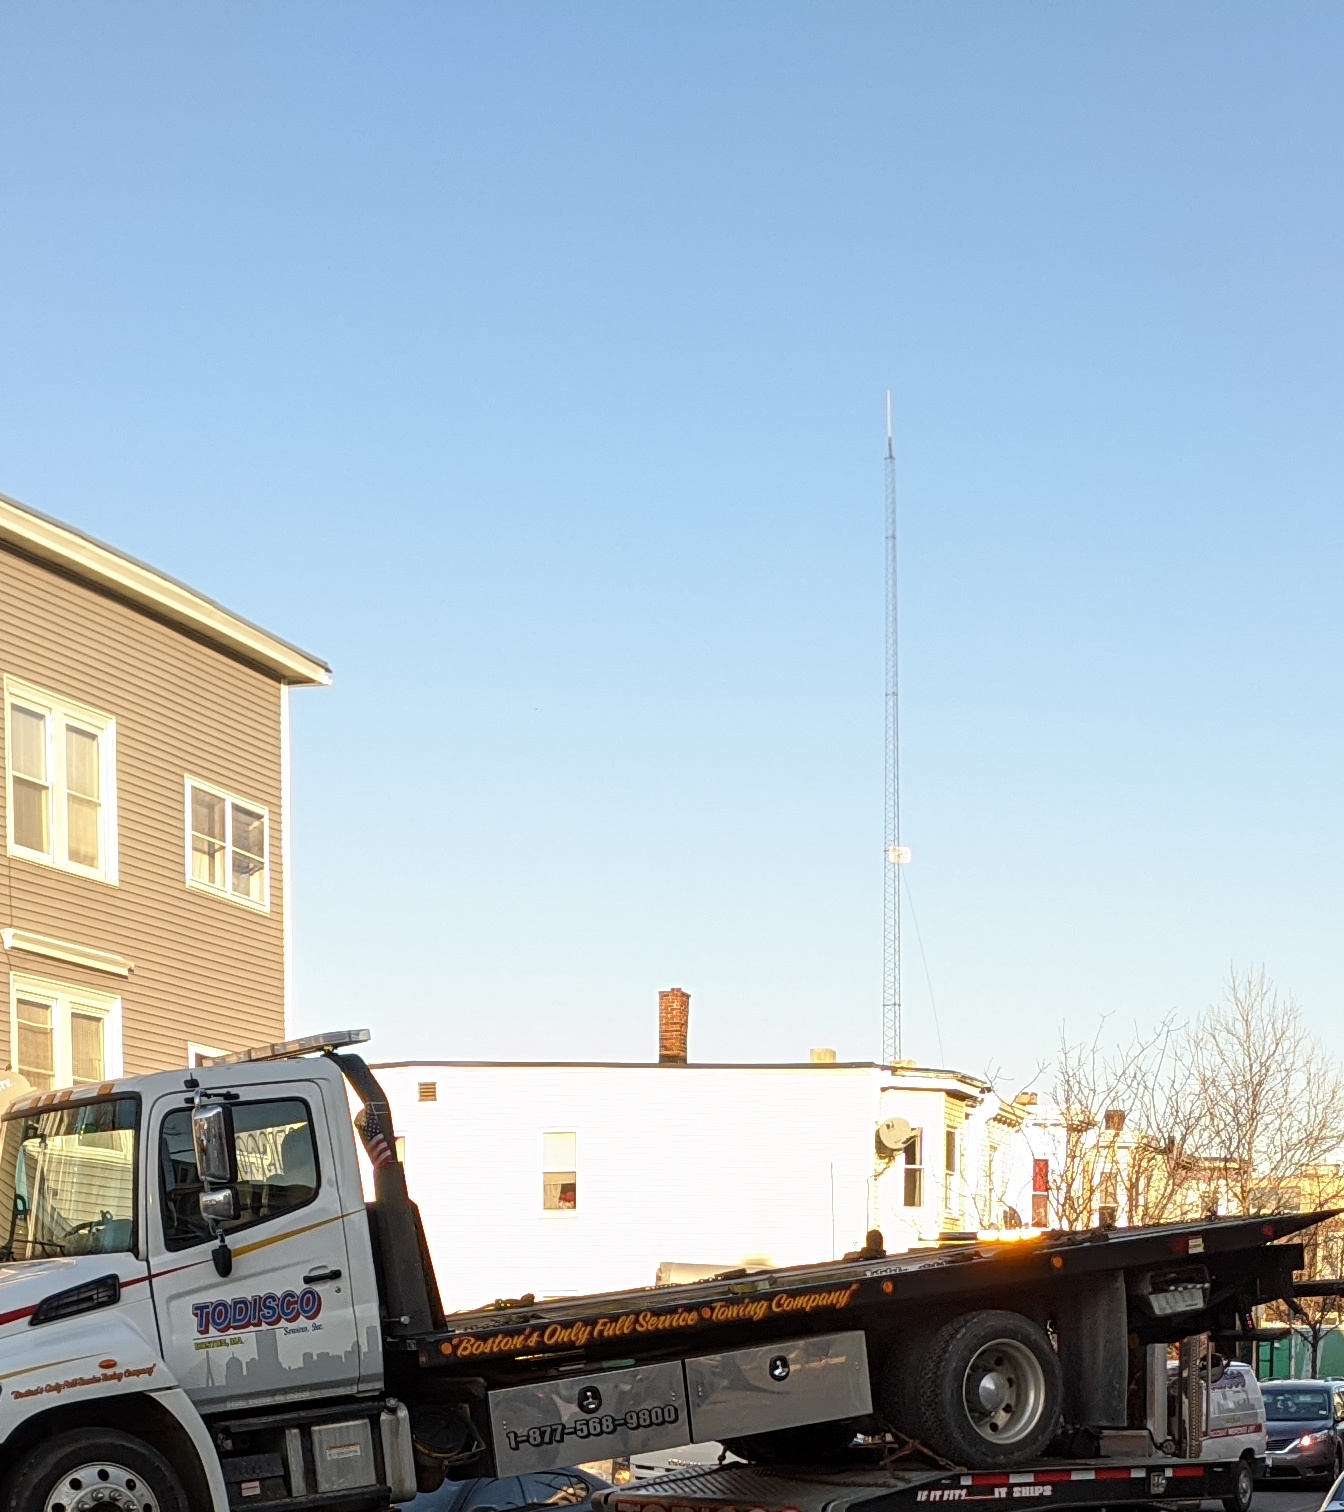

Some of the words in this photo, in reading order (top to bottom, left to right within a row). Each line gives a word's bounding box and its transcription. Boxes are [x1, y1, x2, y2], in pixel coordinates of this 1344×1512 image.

[192, 1286, 322, 1335] TODISCO
[544, 1323, 593, 1346] Only
[593, 1314, 635, 1338] Full
[636, 1308, 699, 1333] Service
[711, 1297, 768, 1322] Towing
[507, 1405, 679, 1450] 1-877-568-9800
[917, 1490, 929, 1502] IF
[930, 1490, 942, 1501] IT
[994, 1487, 1008, 1498] IT
[1012, 1485, 1053, 1498] SHIPS
